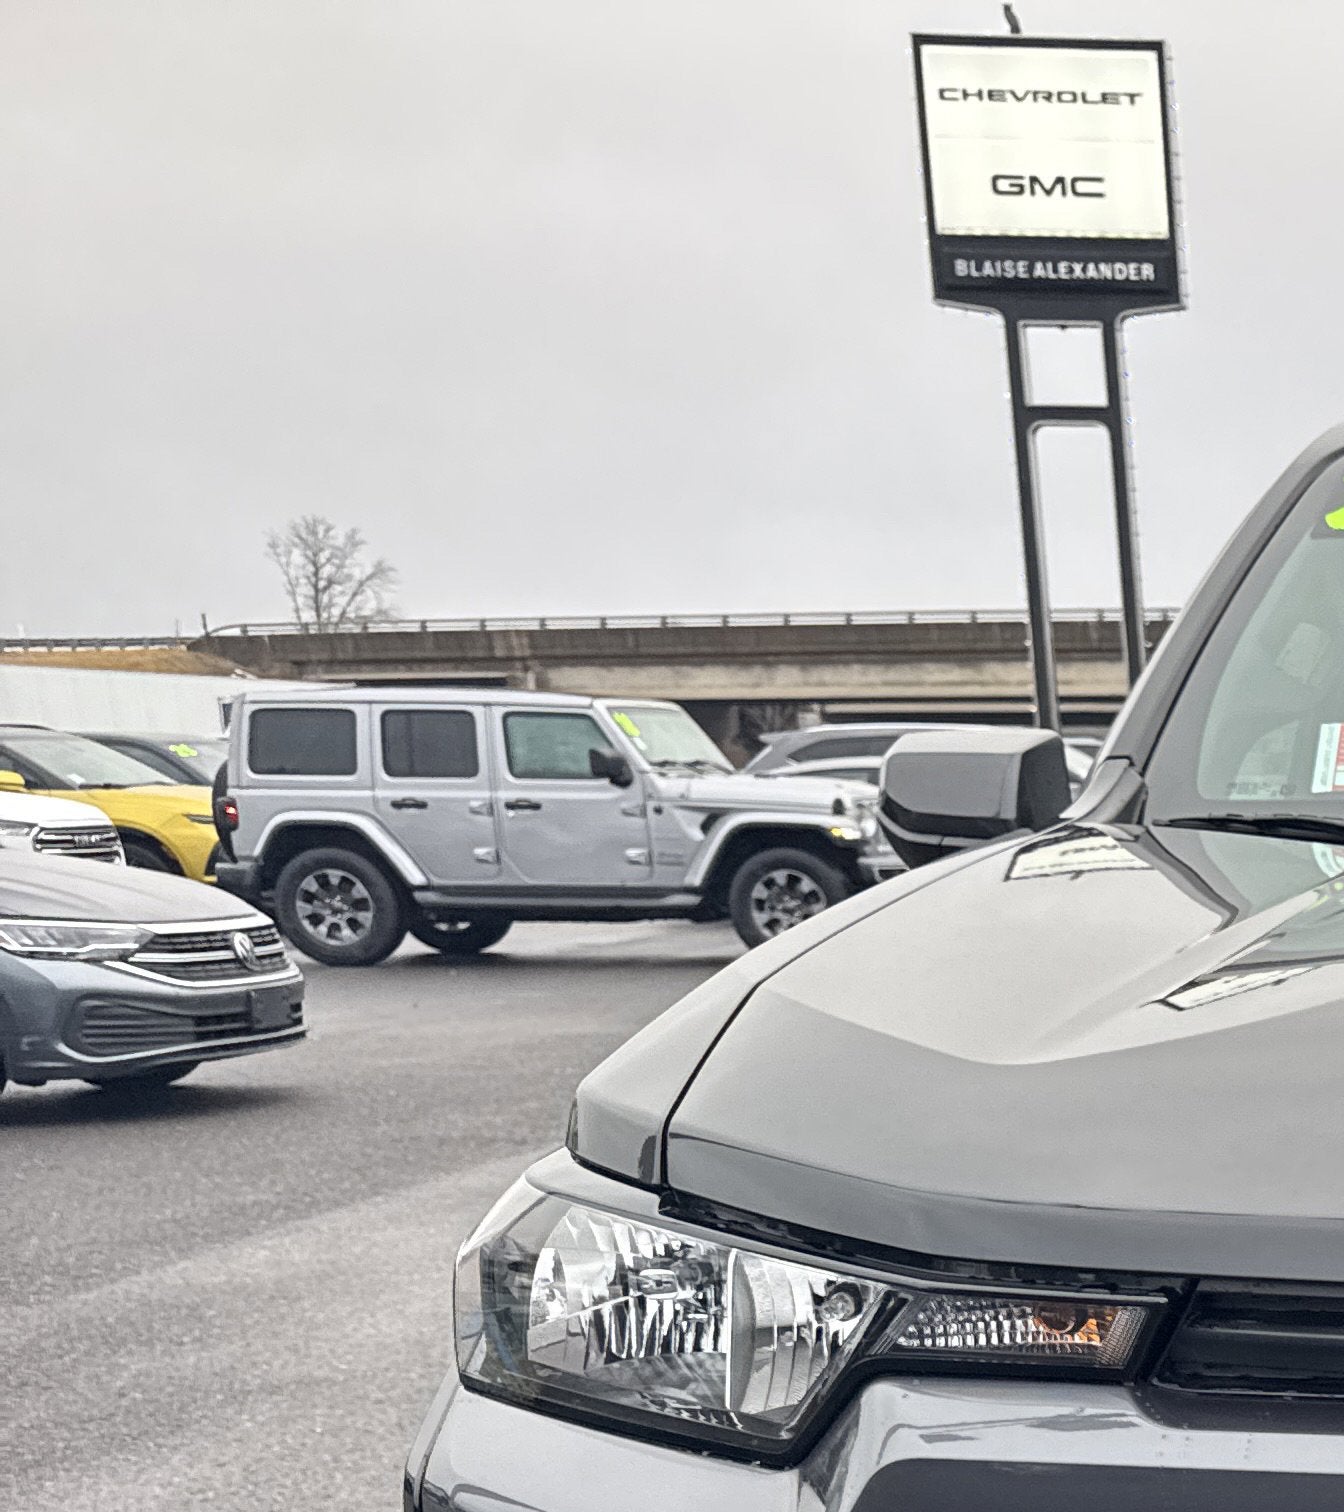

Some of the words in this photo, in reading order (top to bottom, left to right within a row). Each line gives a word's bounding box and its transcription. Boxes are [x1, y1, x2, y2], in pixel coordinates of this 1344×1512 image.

[938, 88, 1143, 106] CHEVROLET
[991, 174, 1106, 198] GMC
[953, 258, 1031, 279] BLAISE
[1032, 260, 1155, 281] ALEXANDER
